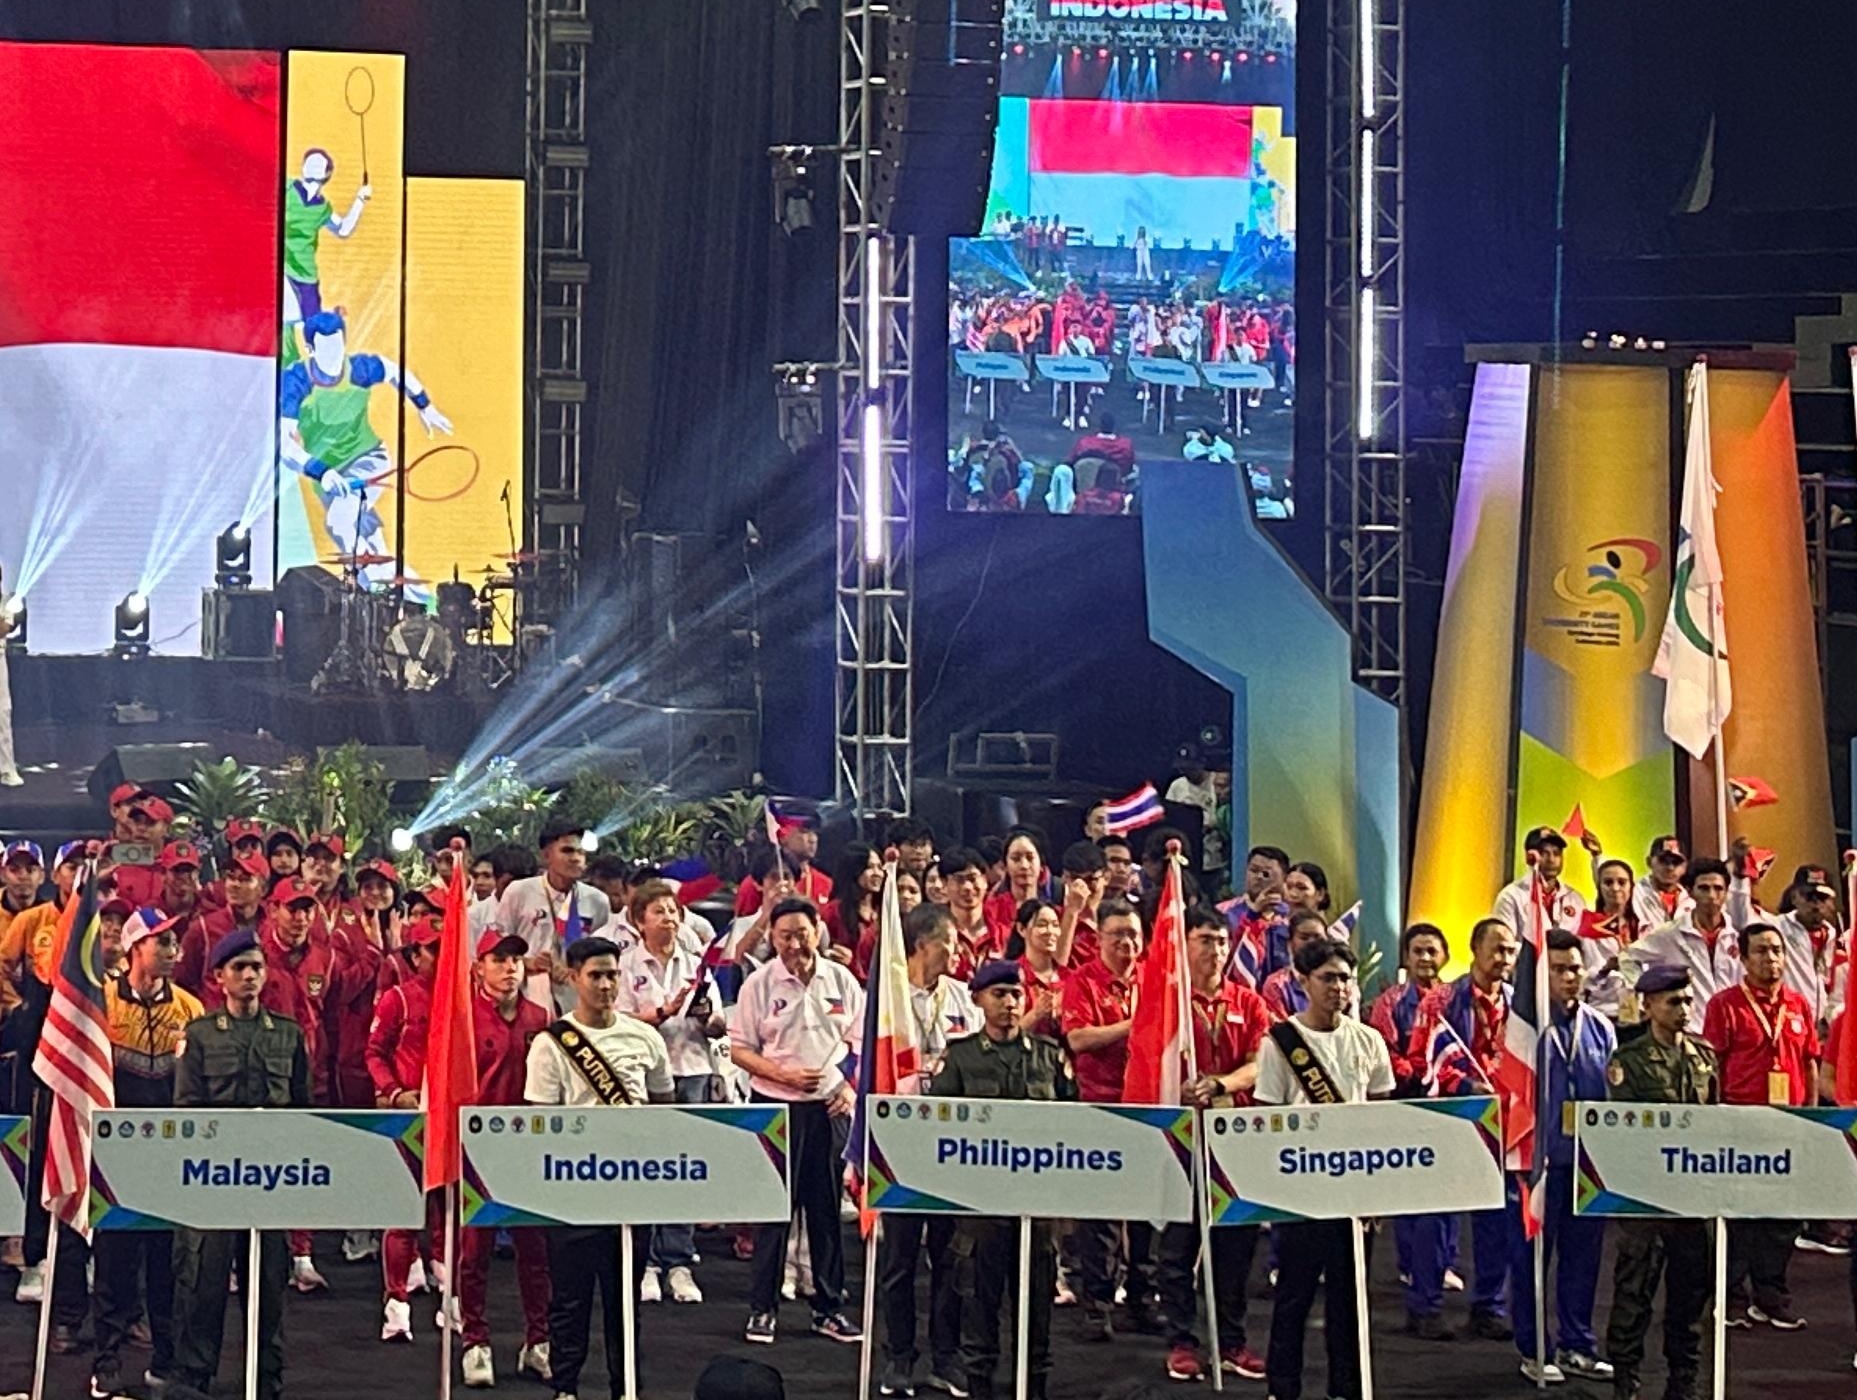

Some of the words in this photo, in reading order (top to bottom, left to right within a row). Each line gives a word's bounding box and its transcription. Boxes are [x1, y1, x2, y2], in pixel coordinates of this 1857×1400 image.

[575, 1046, 616, 1096] PUTRA
[544, 1152, 708, 1182] Indonesia
[937, 1137, 1123, 1174] Philippines
[1279, 1142, 1435, 1177] Singapore
[1660, 1146, 1791, 1175] Thailand
[182, 1157, 331, 1192] Malaysia
